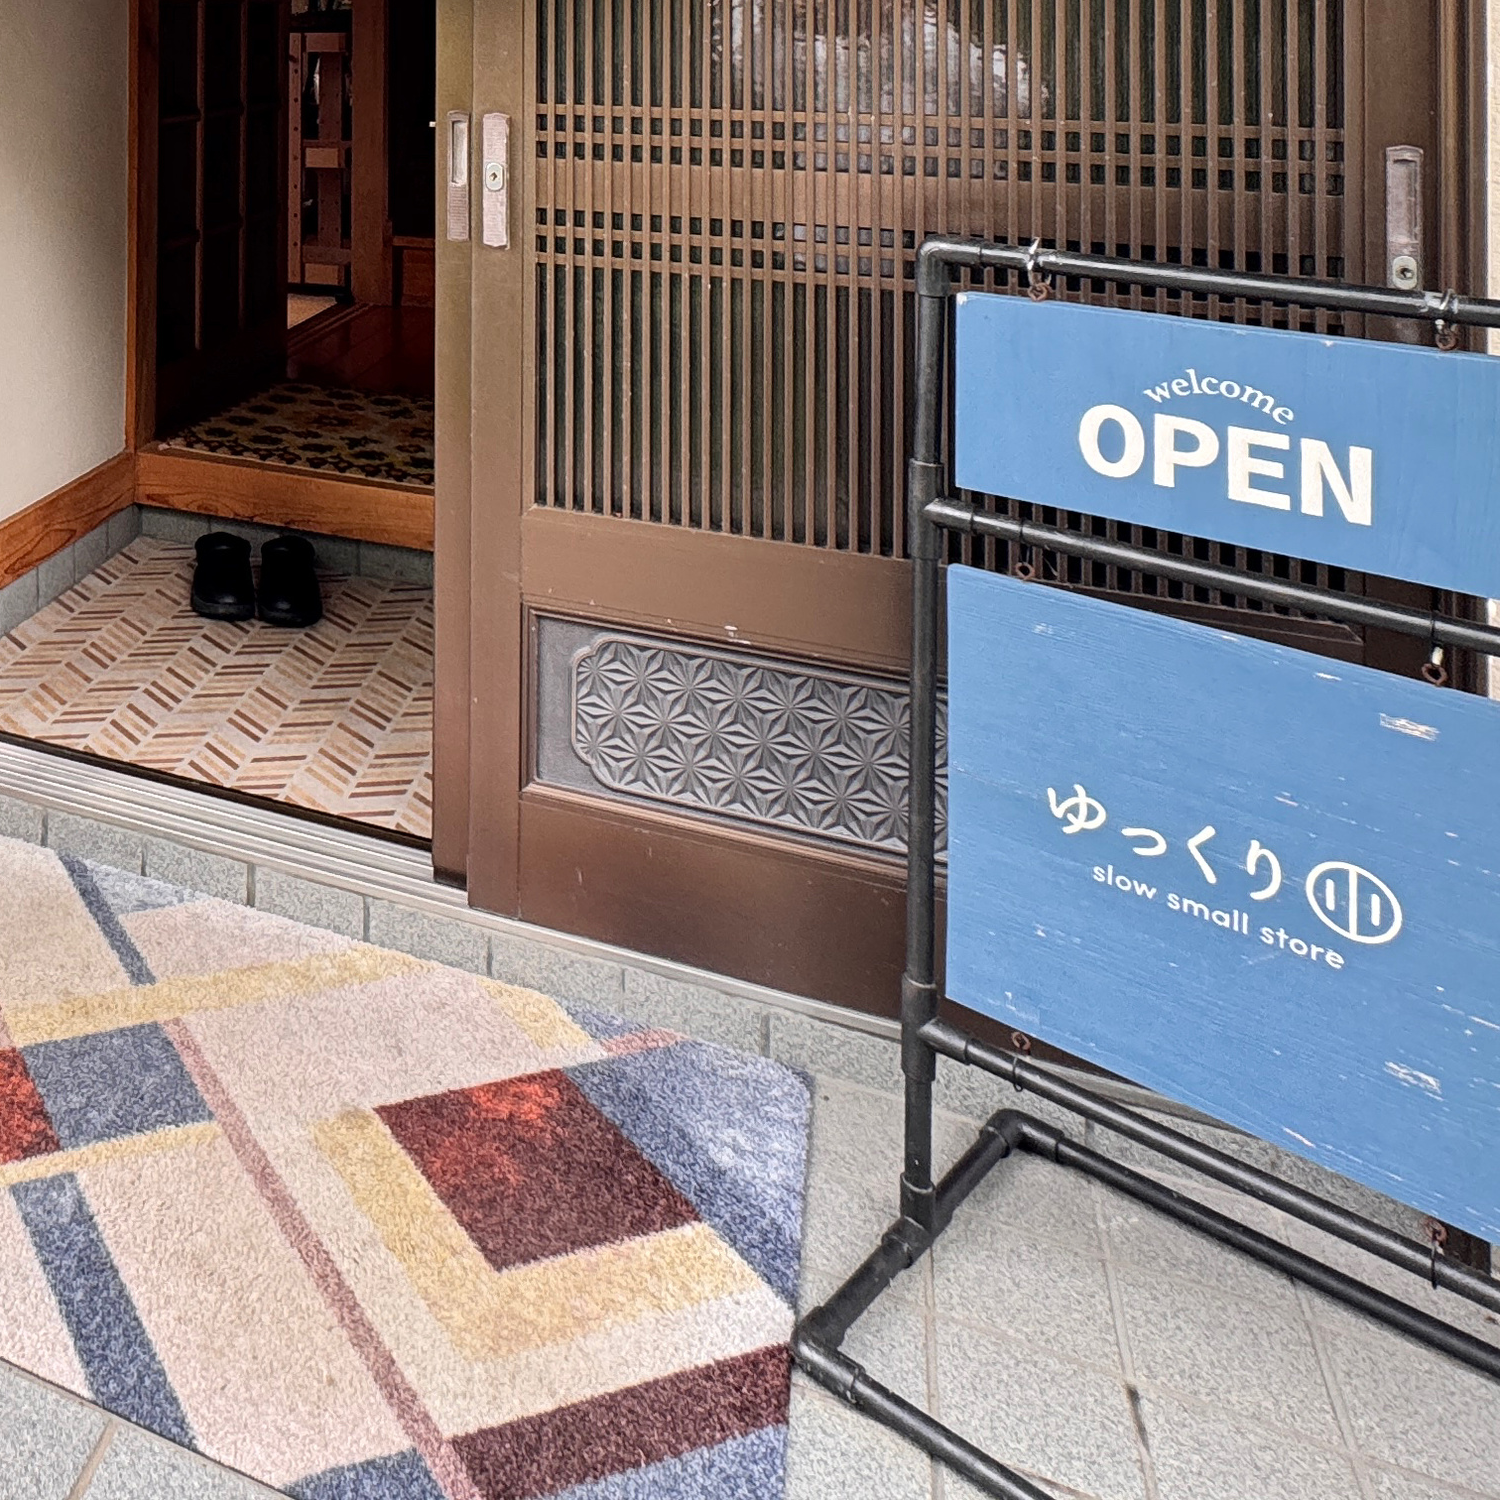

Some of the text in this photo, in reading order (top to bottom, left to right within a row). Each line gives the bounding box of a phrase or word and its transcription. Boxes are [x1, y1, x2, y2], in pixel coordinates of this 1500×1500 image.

[1143, 368, 1295, 426] welcome
[1078, 403, 1373, 527] OPEN
[1092, 864, 1345, 970] slow small store
